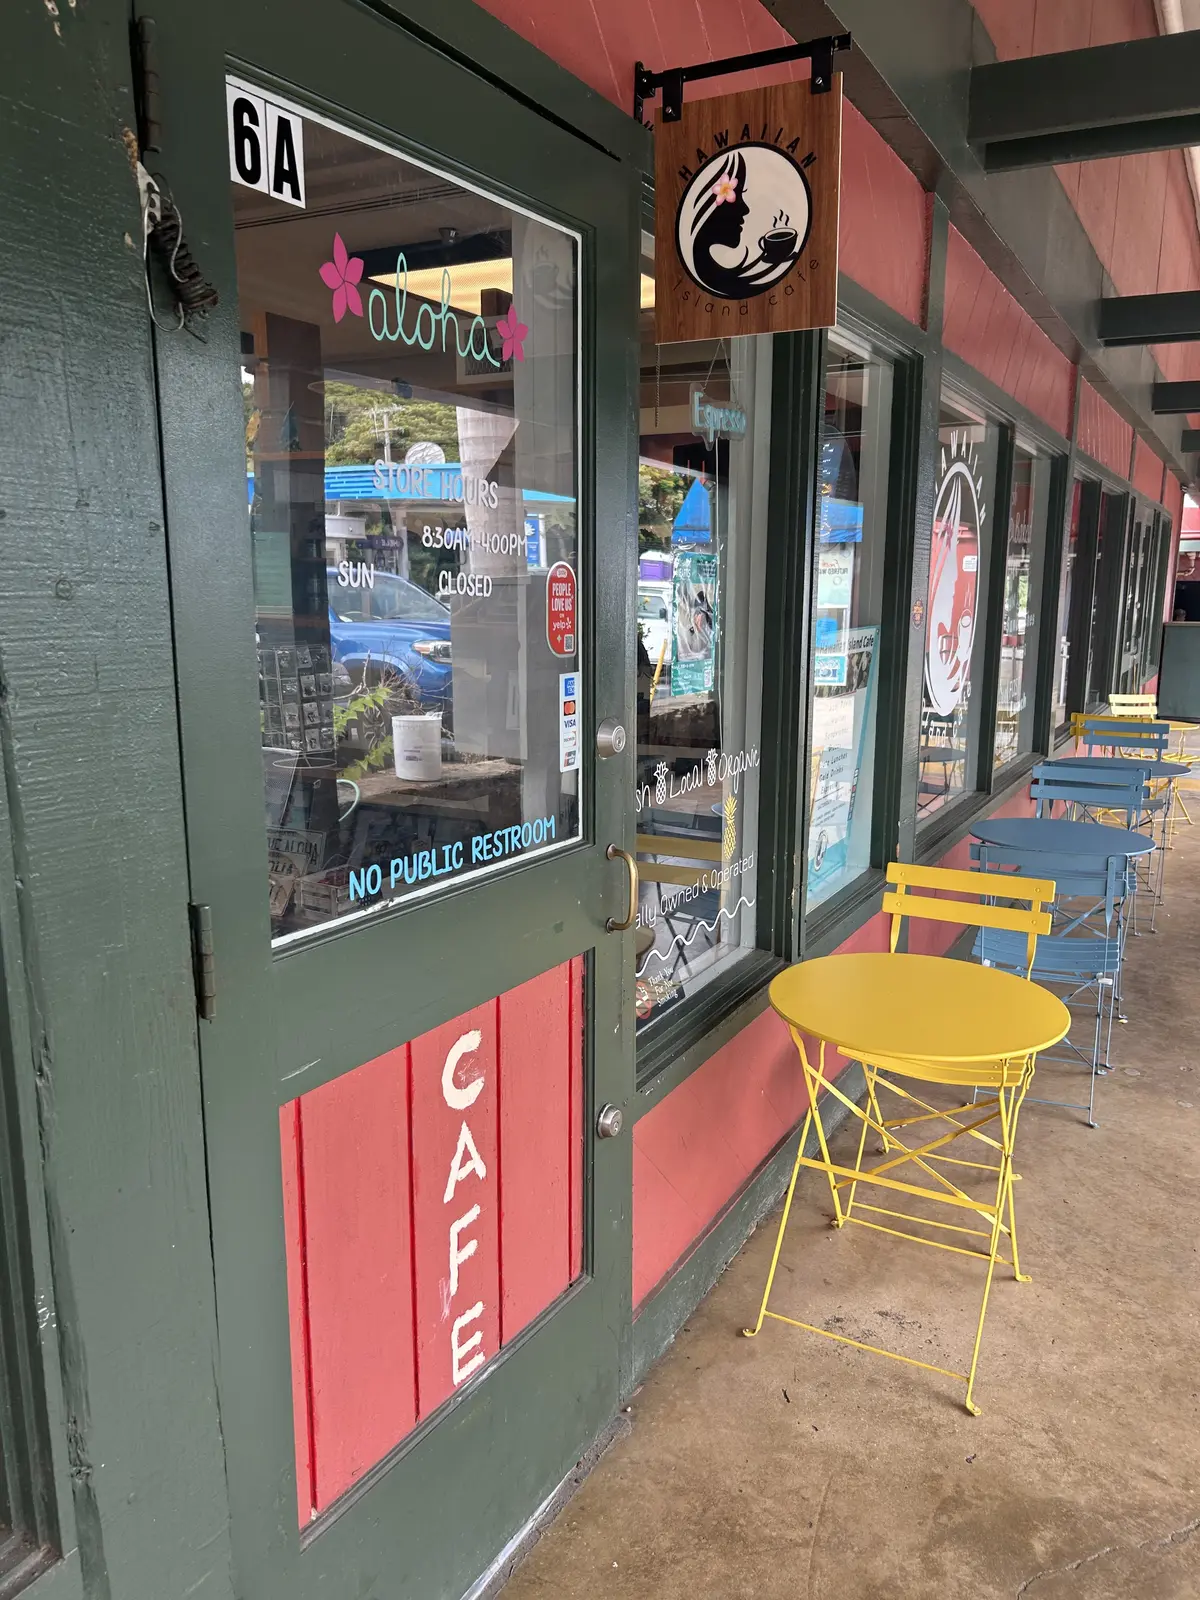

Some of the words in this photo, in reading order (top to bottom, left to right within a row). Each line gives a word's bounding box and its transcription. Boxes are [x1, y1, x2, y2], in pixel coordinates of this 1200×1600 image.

[232, 97, 302, 201] 6A
[678, 123, 817, 182] HAWAIIAN
[368, 252, 500, 368] aloha
[372, 459, 434, 498] STORE
[439, 470, 499, 509] HOURS
[337, 561, 375, 589] SUN
[438, 570, 493, 598] CLOSED
[552, 583, 571, 596] PEOPLE
[552, 598, 565, 612] LOVE
[565, 598, 572, 611] US
[552, 620, 566, 631] yelp
[564, 719, 576, 728] VISA
[669, 758, 704, 798] Local
[349, 864, 382, 901] NO
[390, 841, 463, 889] PUBLIC
[471, 814, 556, 863] RESTROOM
[660, 877, 699, 916] Owned
[702, 873, 708, 894] &
[710, 851, 755, 891] Operated
[441, 1029, 487, 1386] CAFE
